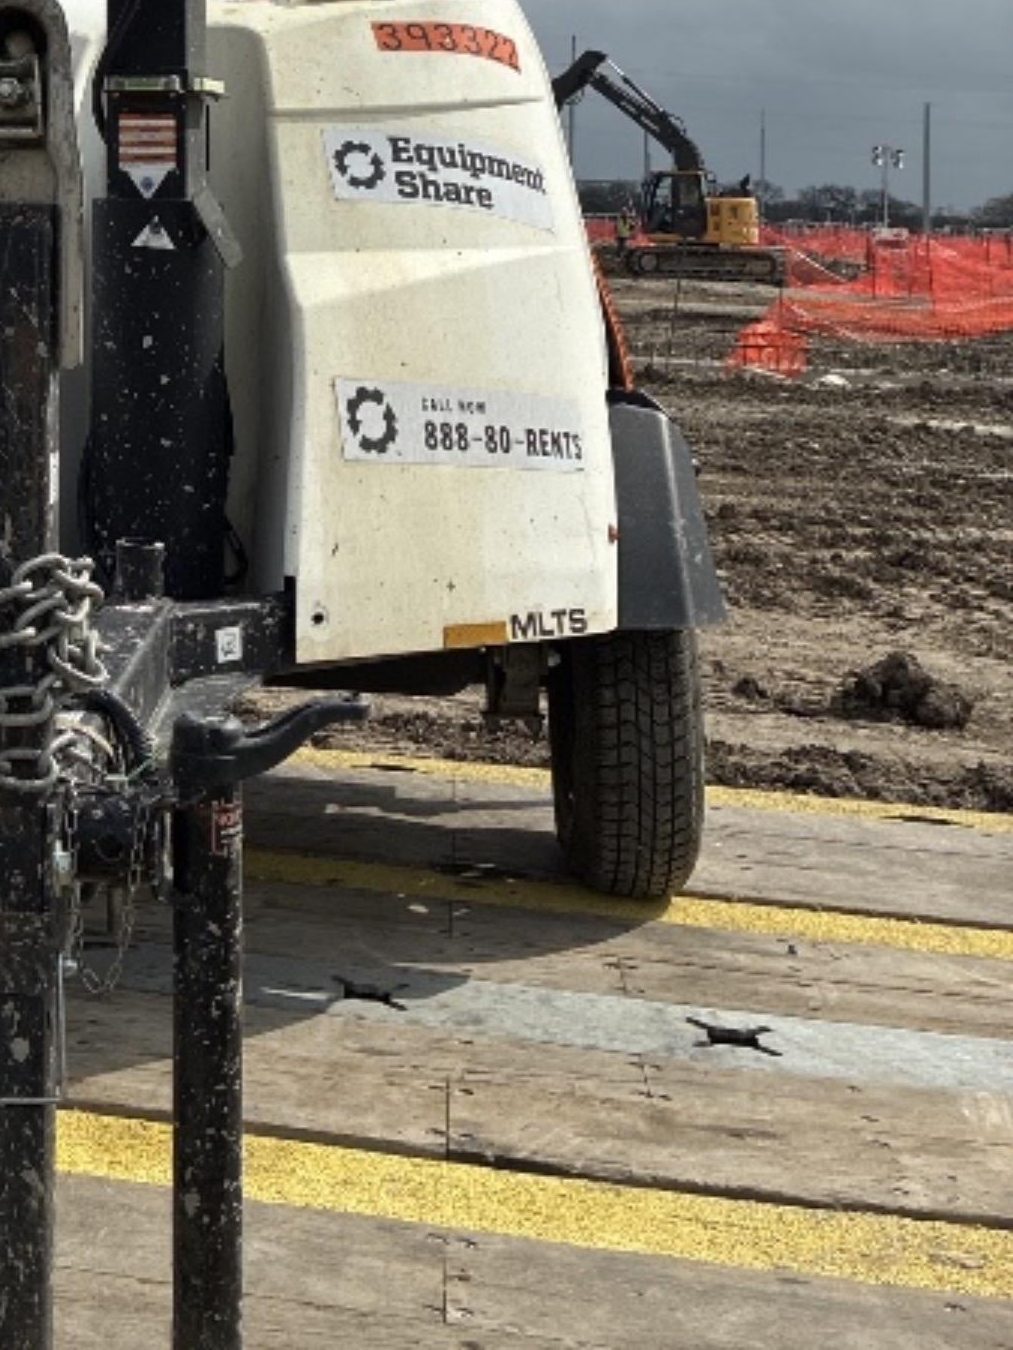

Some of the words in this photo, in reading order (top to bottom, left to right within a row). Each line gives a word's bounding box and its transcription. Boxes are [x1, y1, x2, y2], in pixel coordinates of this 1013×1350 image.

[387, 136, 546, 195] Equipment
[394, 170, 495, 210] Share
[424, 420, 583, 461] 888-80-RENTS
[510, 608, 587, 640] MLTS
